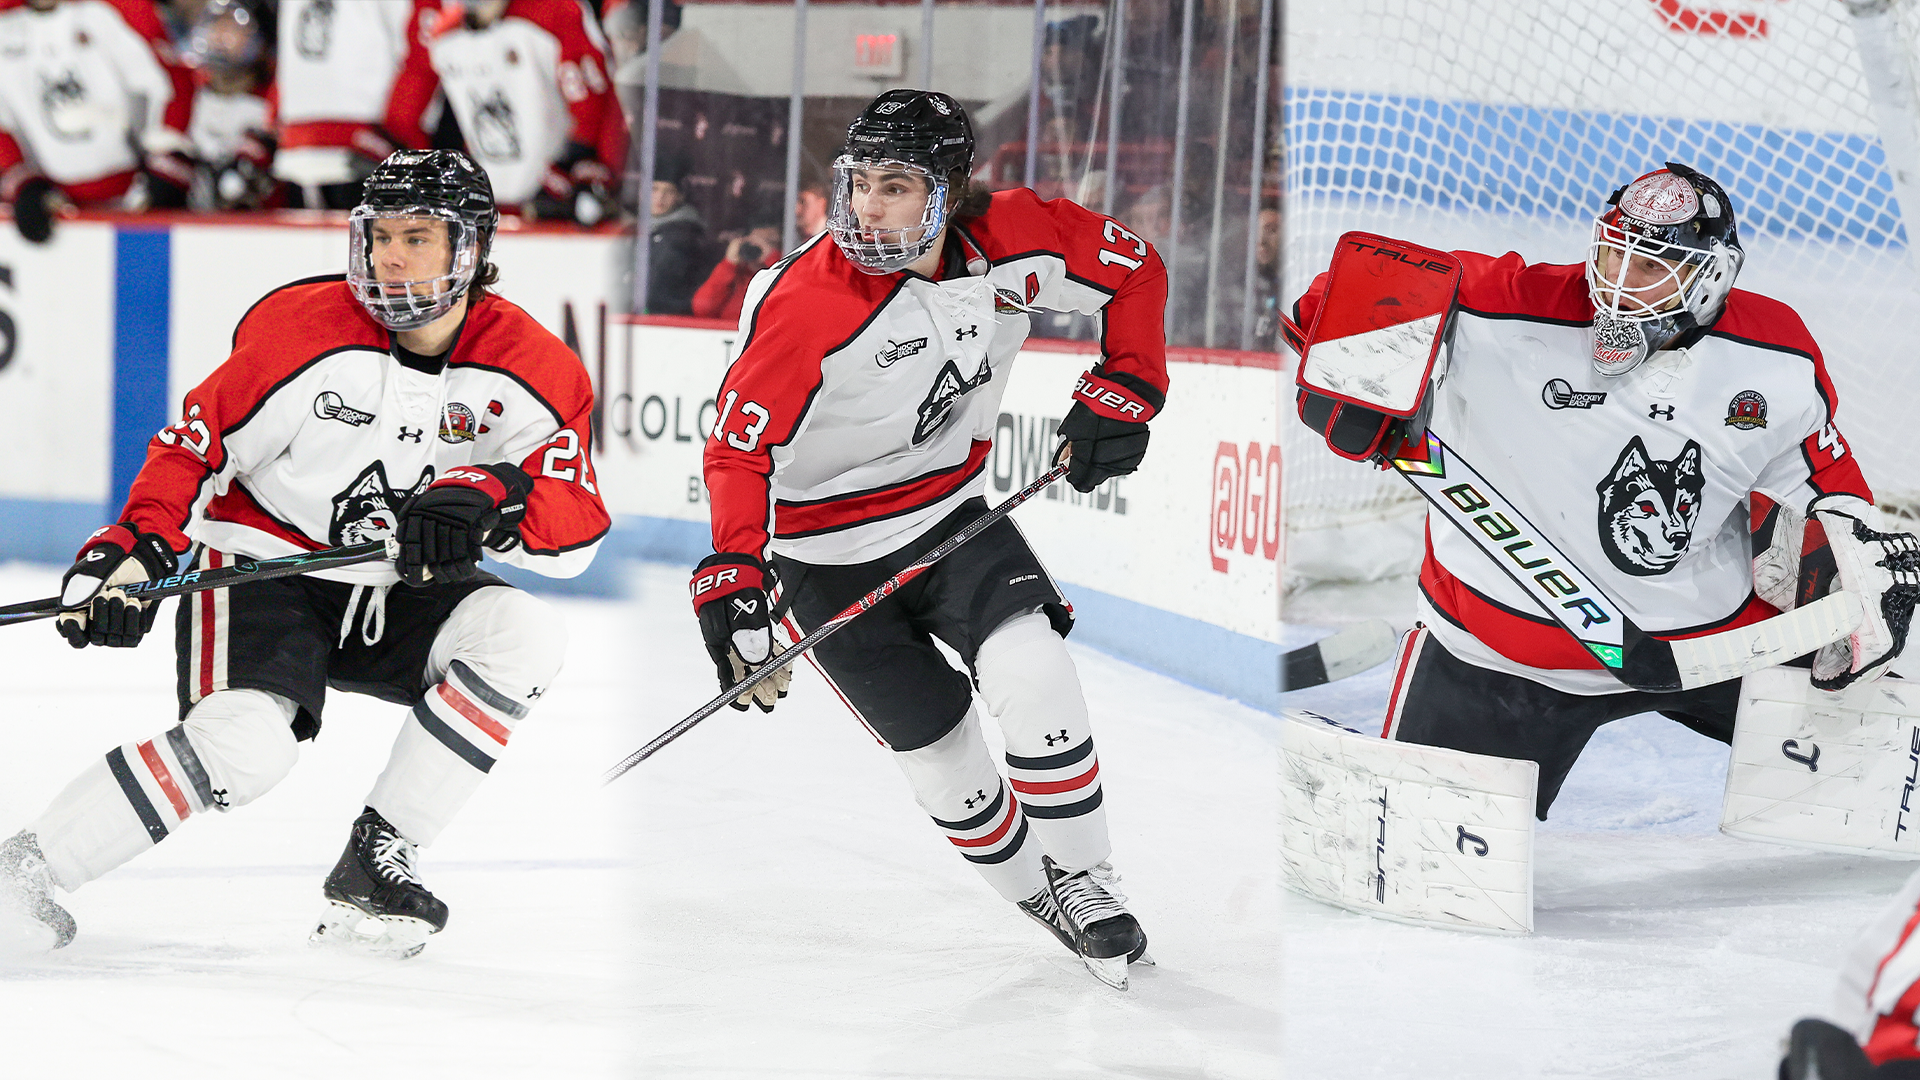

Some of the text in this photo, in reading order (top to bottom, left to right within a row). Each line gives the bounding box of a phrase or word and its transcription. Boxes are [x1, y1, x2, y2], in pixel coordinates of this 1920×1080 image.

[874, 101, 902, 115] 13
[1625, 199, 1673, 220] UNIVERSITY
[1098, 219, 1147, 271] 13
[1347, 241, 1453, 275] TRUE
[1025, 271, 1040, 306] A
[897, 339, 926, 352] HOCKEY
[897, 349, 914, 358] EAST
[1568, 400, 1590, 408] EAST
[1571, 394, 1603, 402] HOCKEY
[336, 413, 356, 425] EAST
[341, 407, 371, 422] HOCKEY
[713, 390, 770, 452] 13
[1817, 422, 1846, 462] 4
[1438, 482, 1611, 630] BAUER
[1008, 573, 1040, 586] BAUER
[1894, 725, 1920, 842] TRUE
[1376, 786, 1388, 905] TRUE
